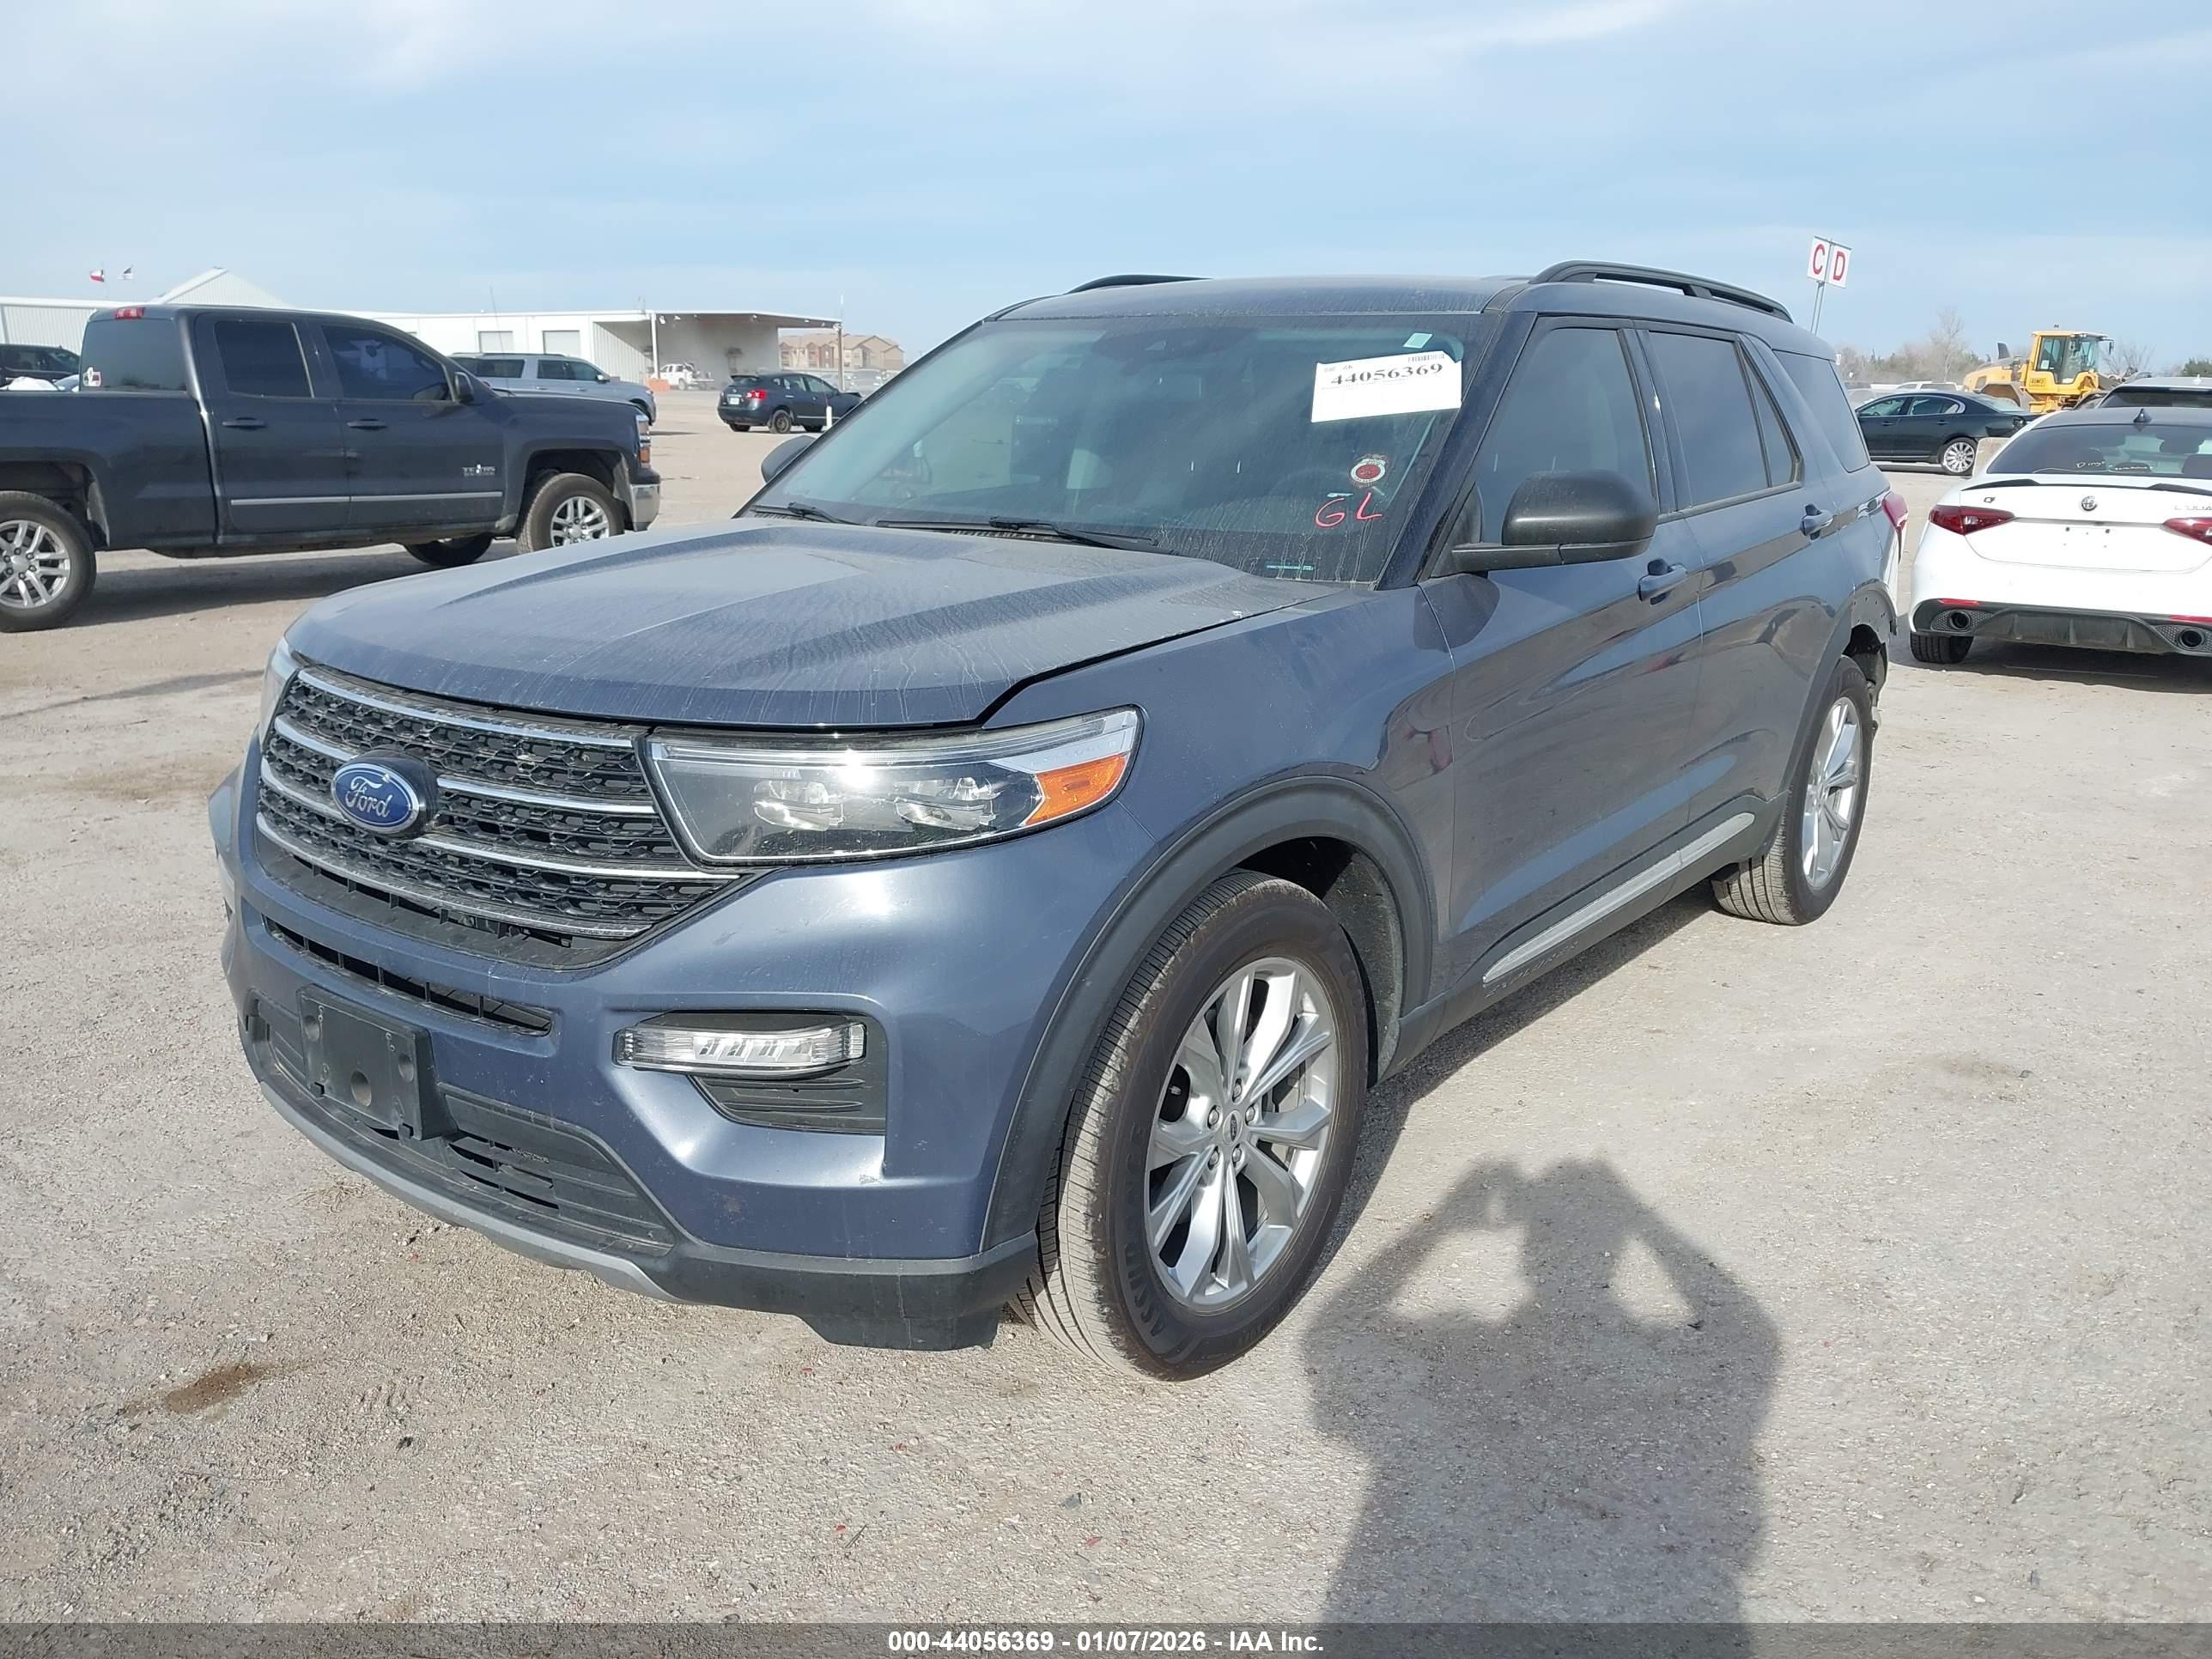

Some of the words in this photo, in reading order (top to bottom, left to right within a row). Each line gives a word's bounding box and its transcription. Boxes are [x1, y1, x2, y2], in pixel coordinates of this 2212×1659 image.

[1813, 244, 1826, 275] C
[1832, 251, 1846, 281] D
[1330, 363, 1443, 386] 44056369
[345, 775, 393, 817] Ford
